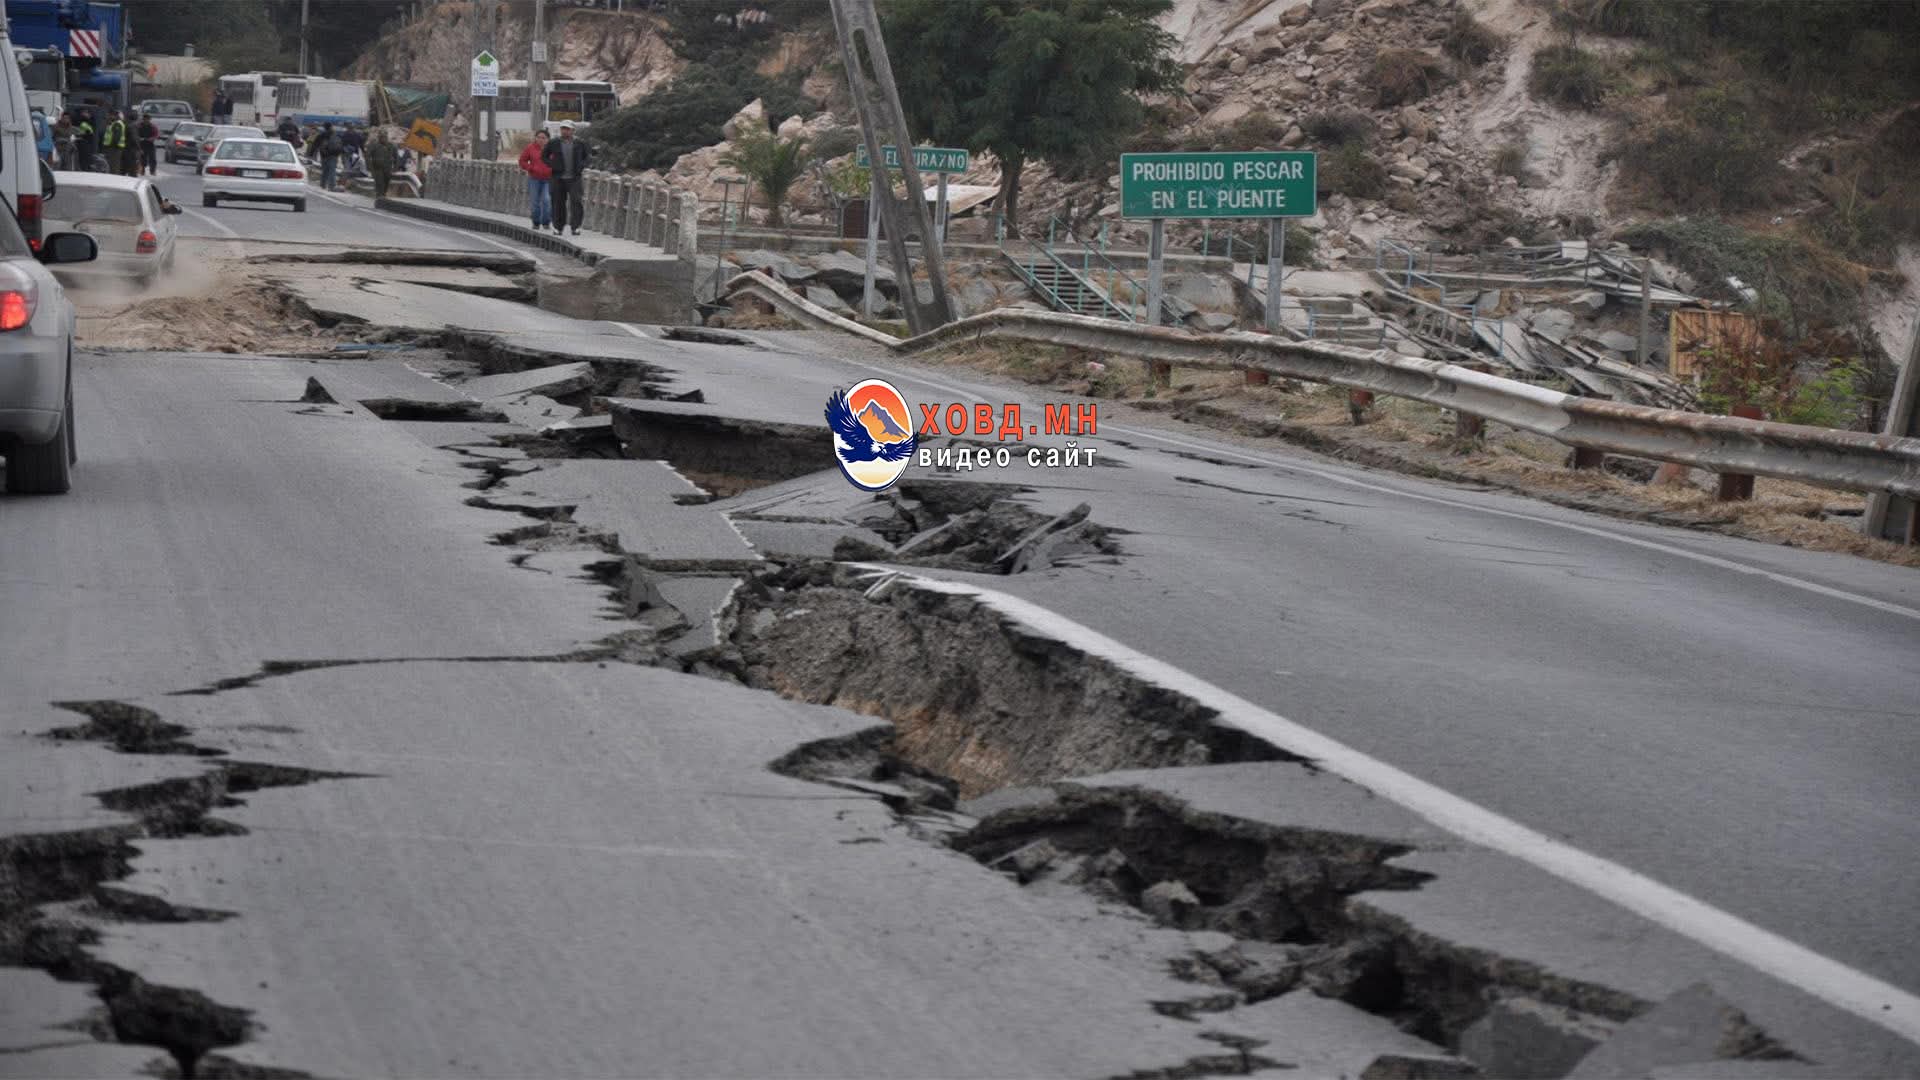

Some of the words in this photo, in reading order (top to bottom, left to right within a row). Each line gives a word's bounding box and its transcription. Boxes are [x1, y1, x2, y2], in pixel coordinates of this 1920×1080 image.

[1133, 162, 1224, 181] PROHIBIDO
[1233, 161, 1303, 180] PESCAR
[1151, 190, 1175, 209] EN
[1187, 190, 1208, 209] EL
[1218, 189, 1286, 209] PUENTE
